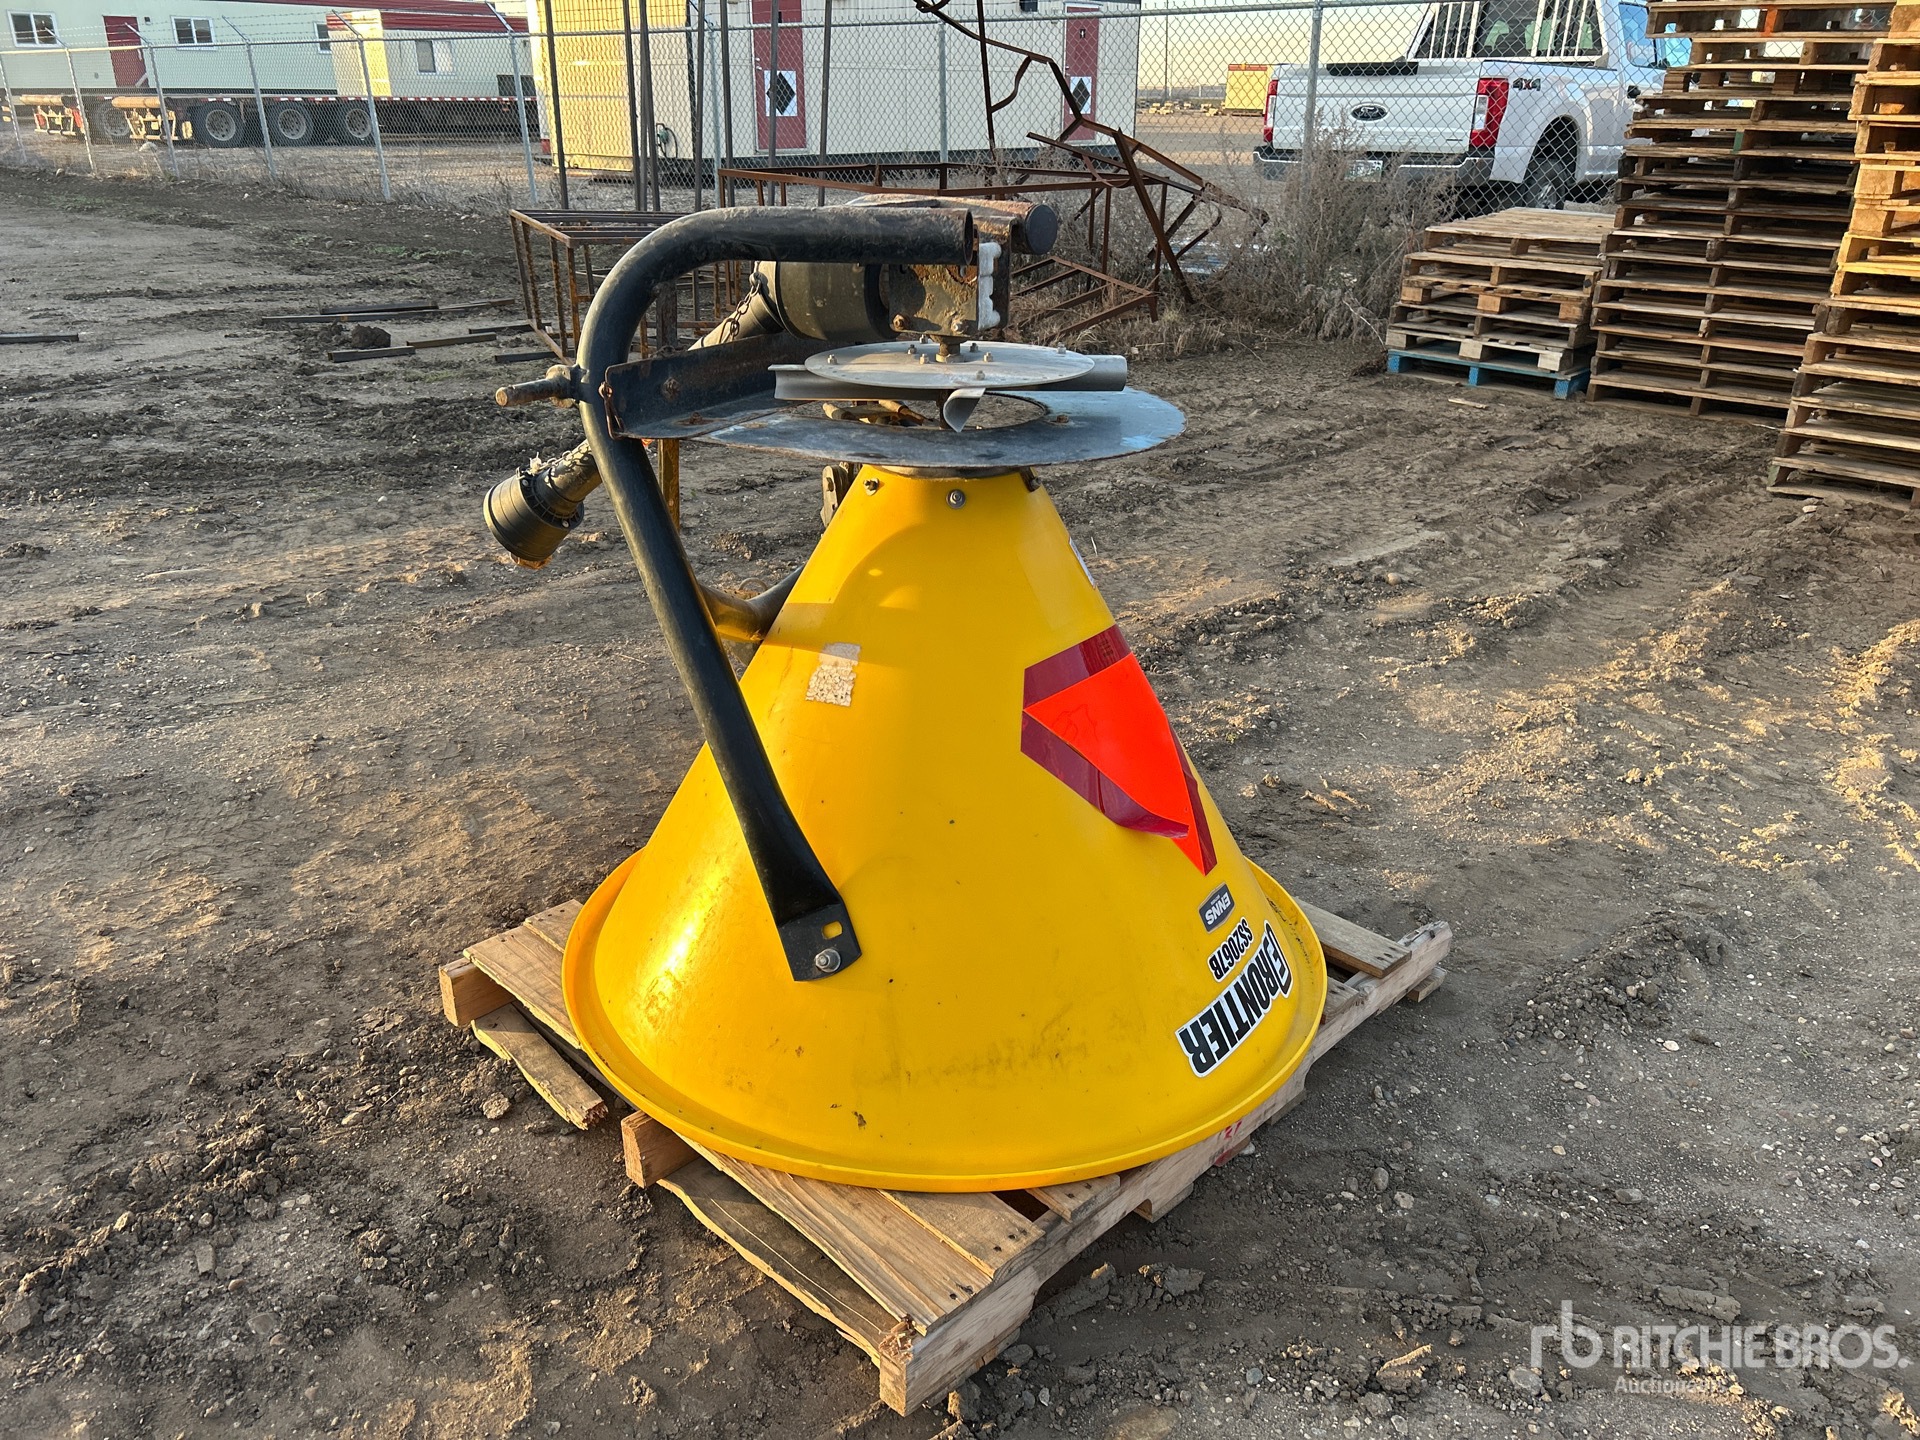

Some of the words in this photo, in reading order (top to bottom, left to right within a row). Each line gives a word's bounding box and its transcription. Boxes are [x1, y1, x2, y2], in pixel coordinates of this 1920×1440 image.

[1204, 891, 1230, 925] ENNS
[1208, 918, 1254, 980] SS2067B
[1178, 922, 1292, 1074] FRONTIER
